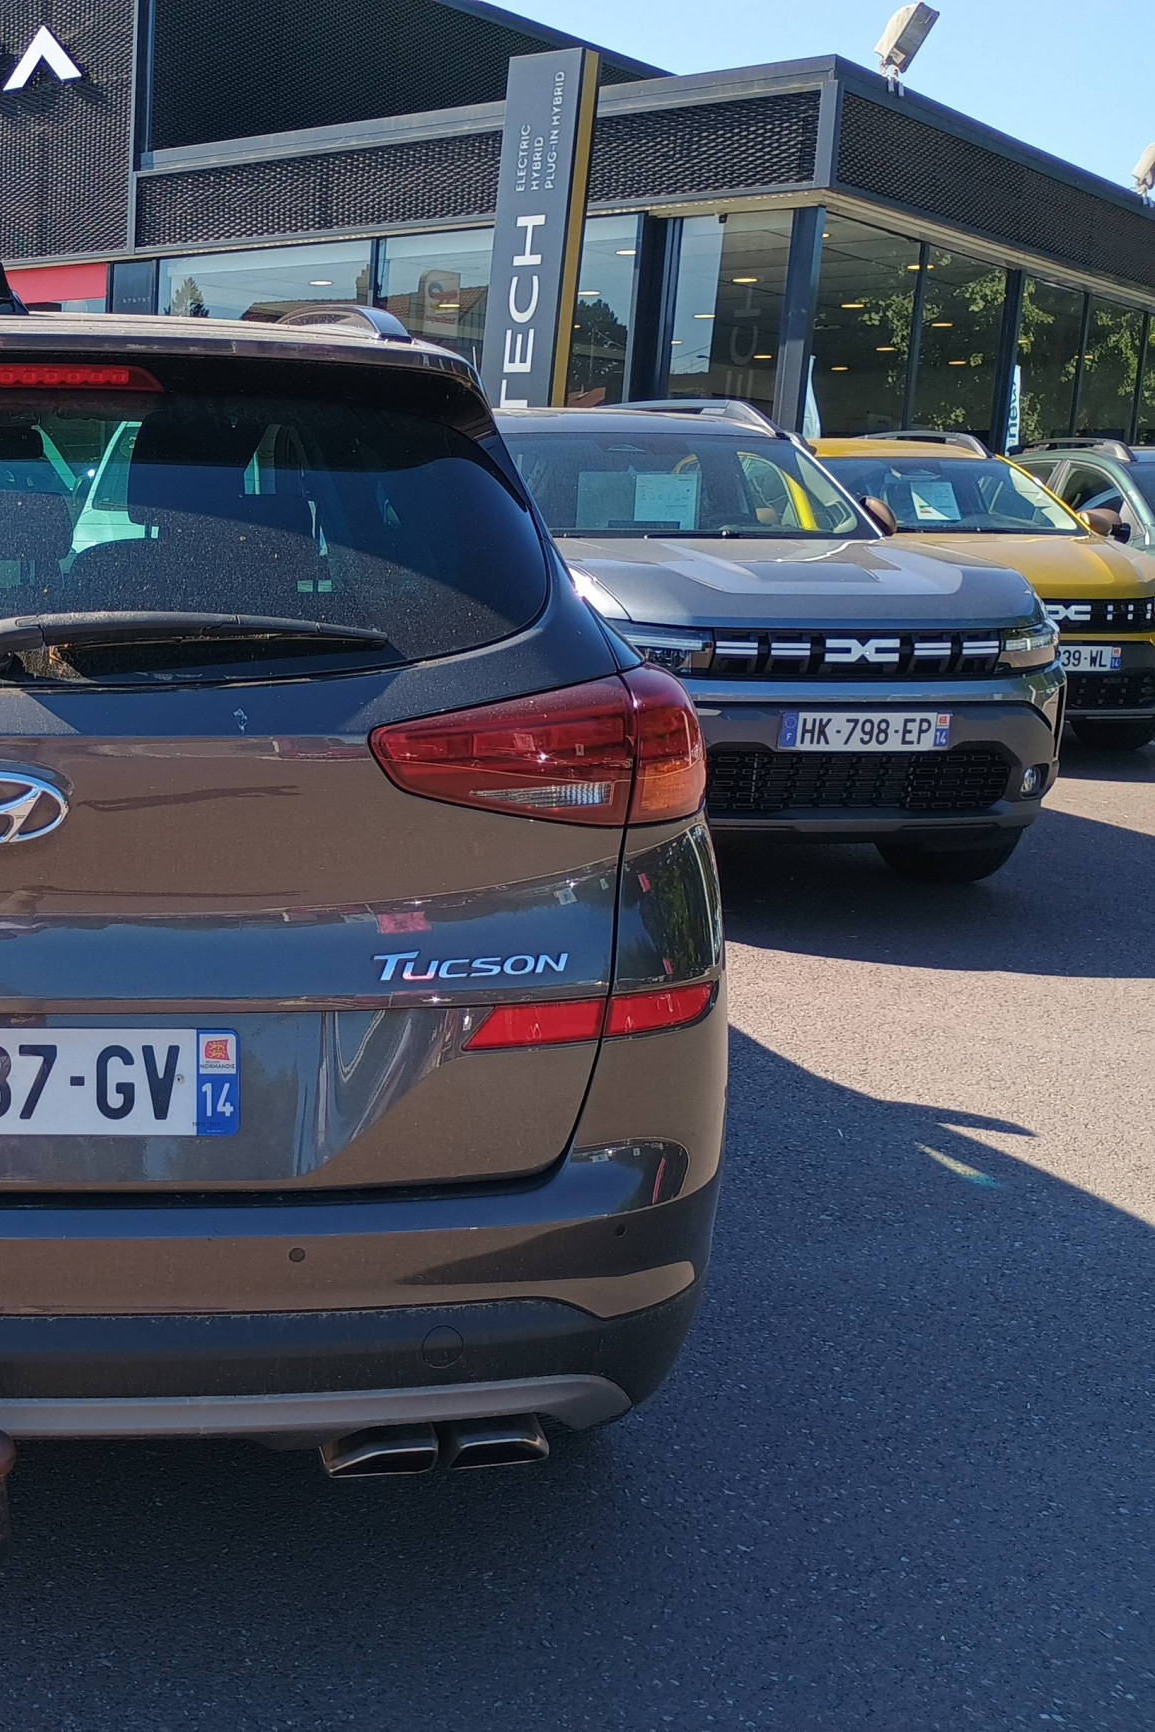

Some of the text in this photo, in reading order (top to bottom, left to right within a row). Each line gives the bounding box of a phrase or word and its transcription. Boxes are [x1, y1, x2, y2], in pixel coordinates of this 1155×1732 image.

[544, 71, 565, 189] PLUG-IN HYBRID
[515, 124, 531, 192] ELECTRIC
[530, 136, 544, 191] HYBRID
[786, 732, 793, 741] F
[799, 717, 932, 746] HK-798-EP
[935, 731, 947, 744] 14
[201, 1082, 234, 1117] 14
